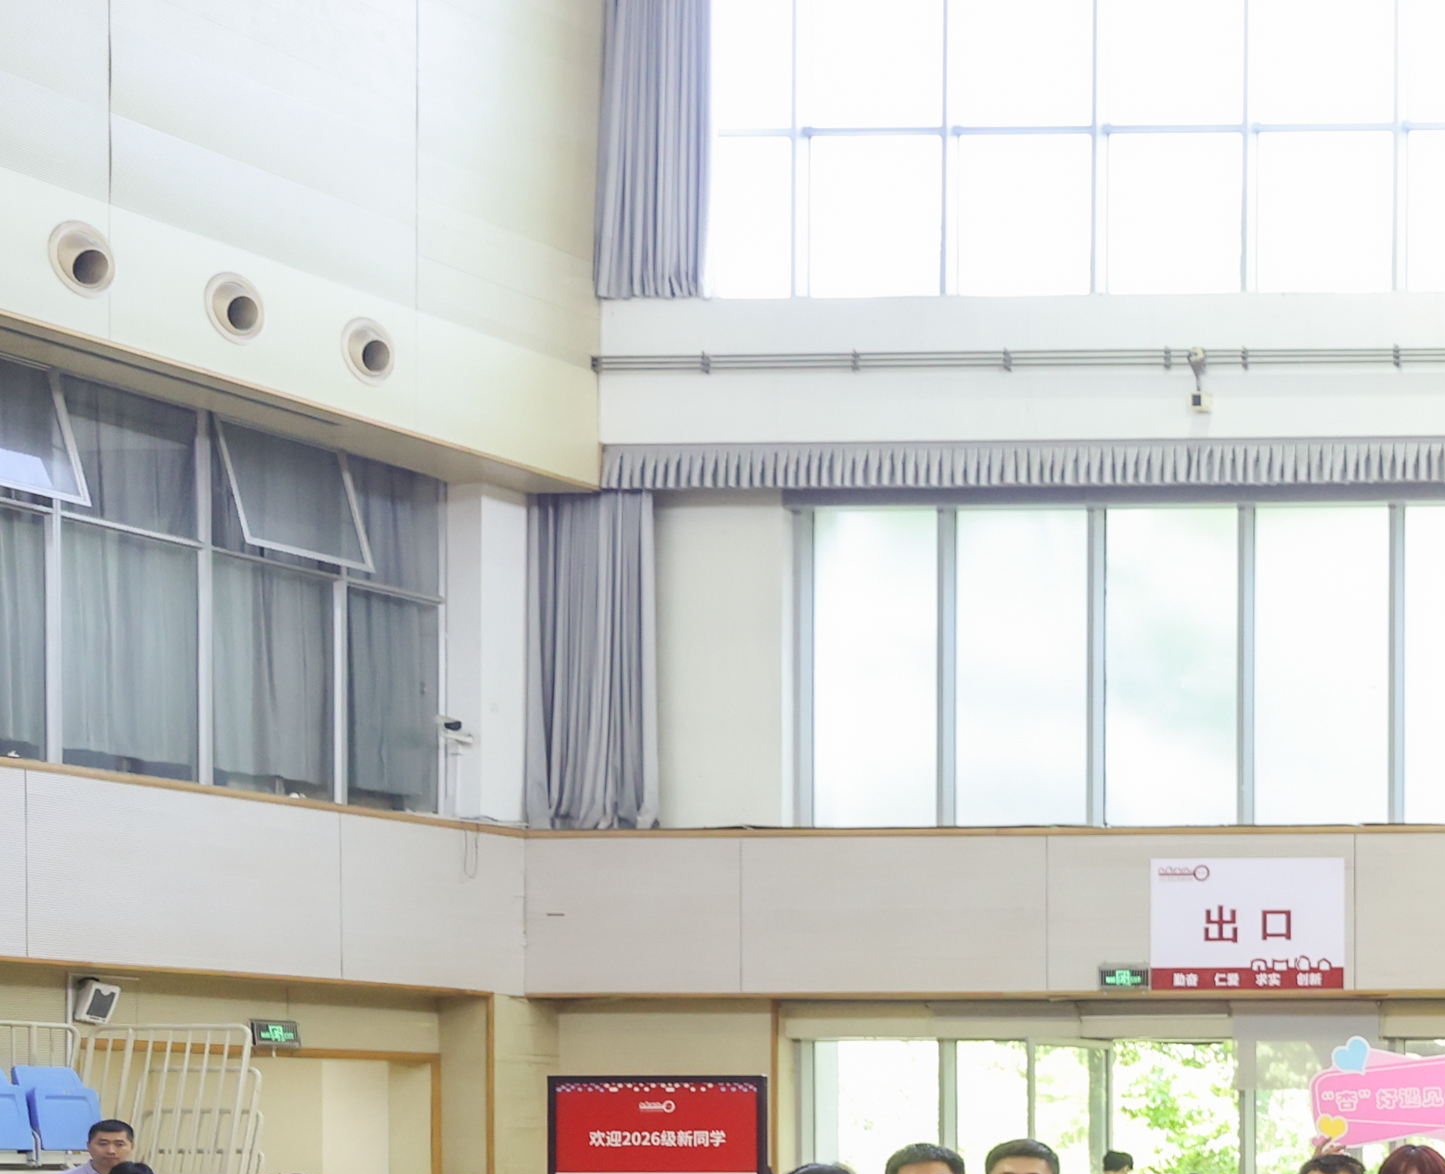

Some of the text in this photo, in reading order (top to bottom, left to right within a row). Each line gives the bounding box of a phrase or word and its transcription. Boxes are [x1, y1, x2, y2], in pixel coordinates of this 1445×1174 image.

[1204, 905, 1291, 943] 出口
[1173, 973, 1322, 987] 勤奋 仁爱 求实 创新
[589, 1130, 726, 1147] 欢迎2026级新同学
